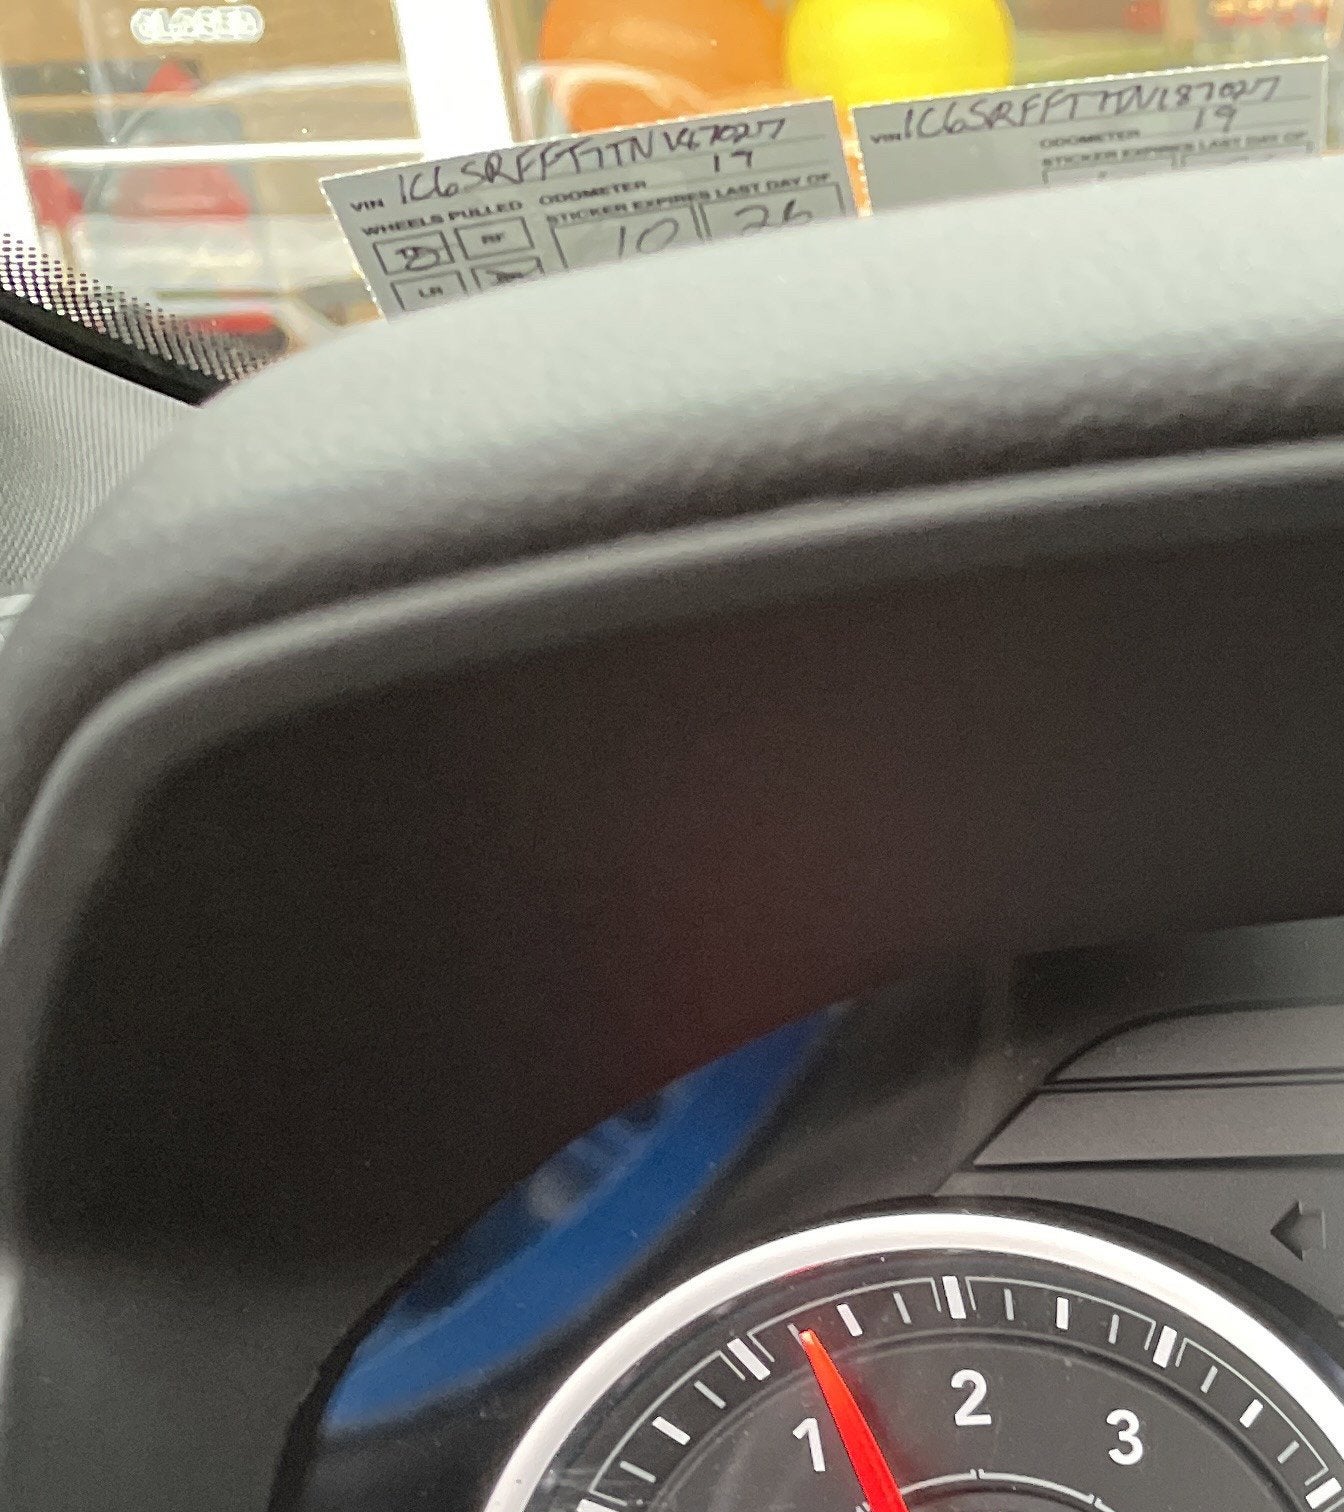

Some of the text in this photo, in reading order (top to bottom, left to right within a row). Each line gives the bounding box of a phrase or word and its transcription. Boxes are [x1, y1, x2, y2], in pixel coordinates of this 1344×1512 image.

[351, 198, 384, 212] VIN
[539, 180, 646, 205] ODOMETER
[547, 203, 627, 223] STICKER
[716, 183, 760, 199] LAST
[767, 176, 800, 191] DAY
[363, 201, 523, 236] WHEELS PULLED
[951, 1370, 992, 1425] 2
[793, 1418, 826, 1471] 1
[1107, 1410, 1144, 1465] 3
